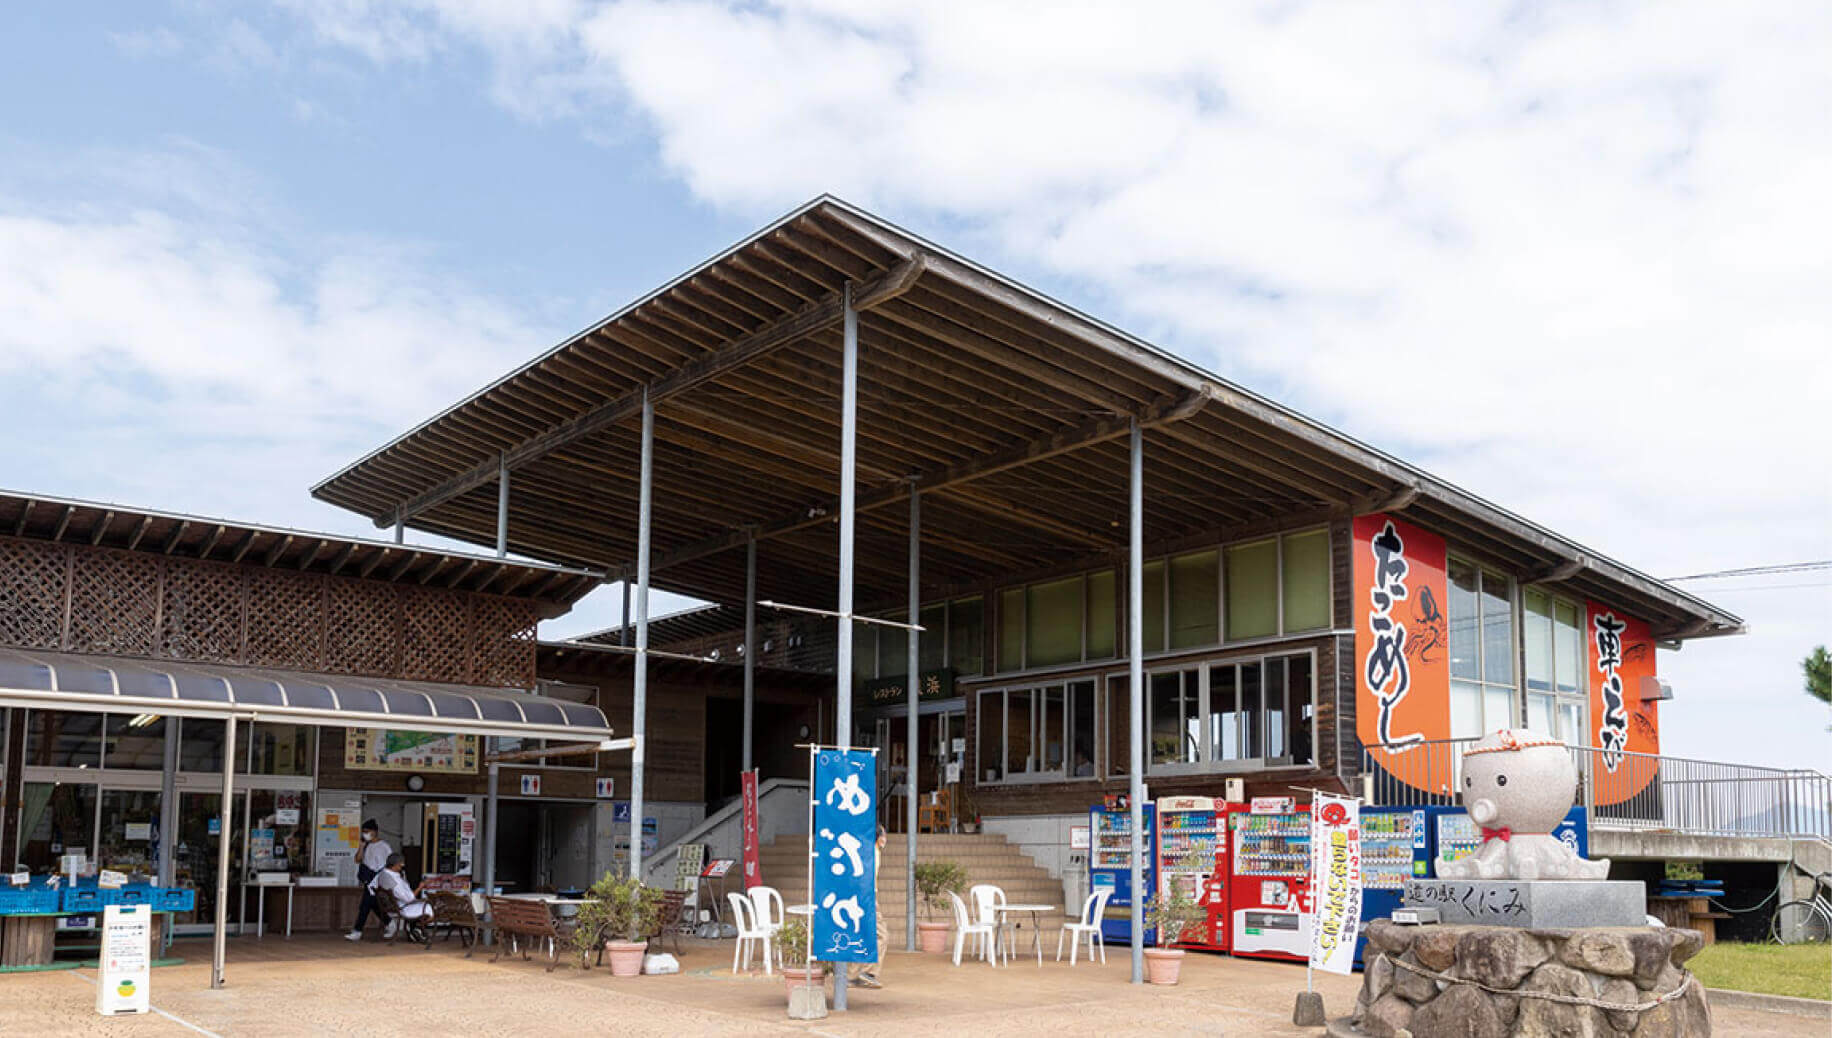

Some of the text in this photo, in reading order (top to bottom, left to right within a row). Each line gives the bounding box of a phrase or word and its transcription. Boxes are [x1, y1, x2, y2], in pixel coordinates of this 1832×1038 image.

[1367, 520, 1424, 755] たこめし
[1594, 612, 1627, 772] 車えび
[1408, 883, 1527, 919] 道の駅 くにみ
